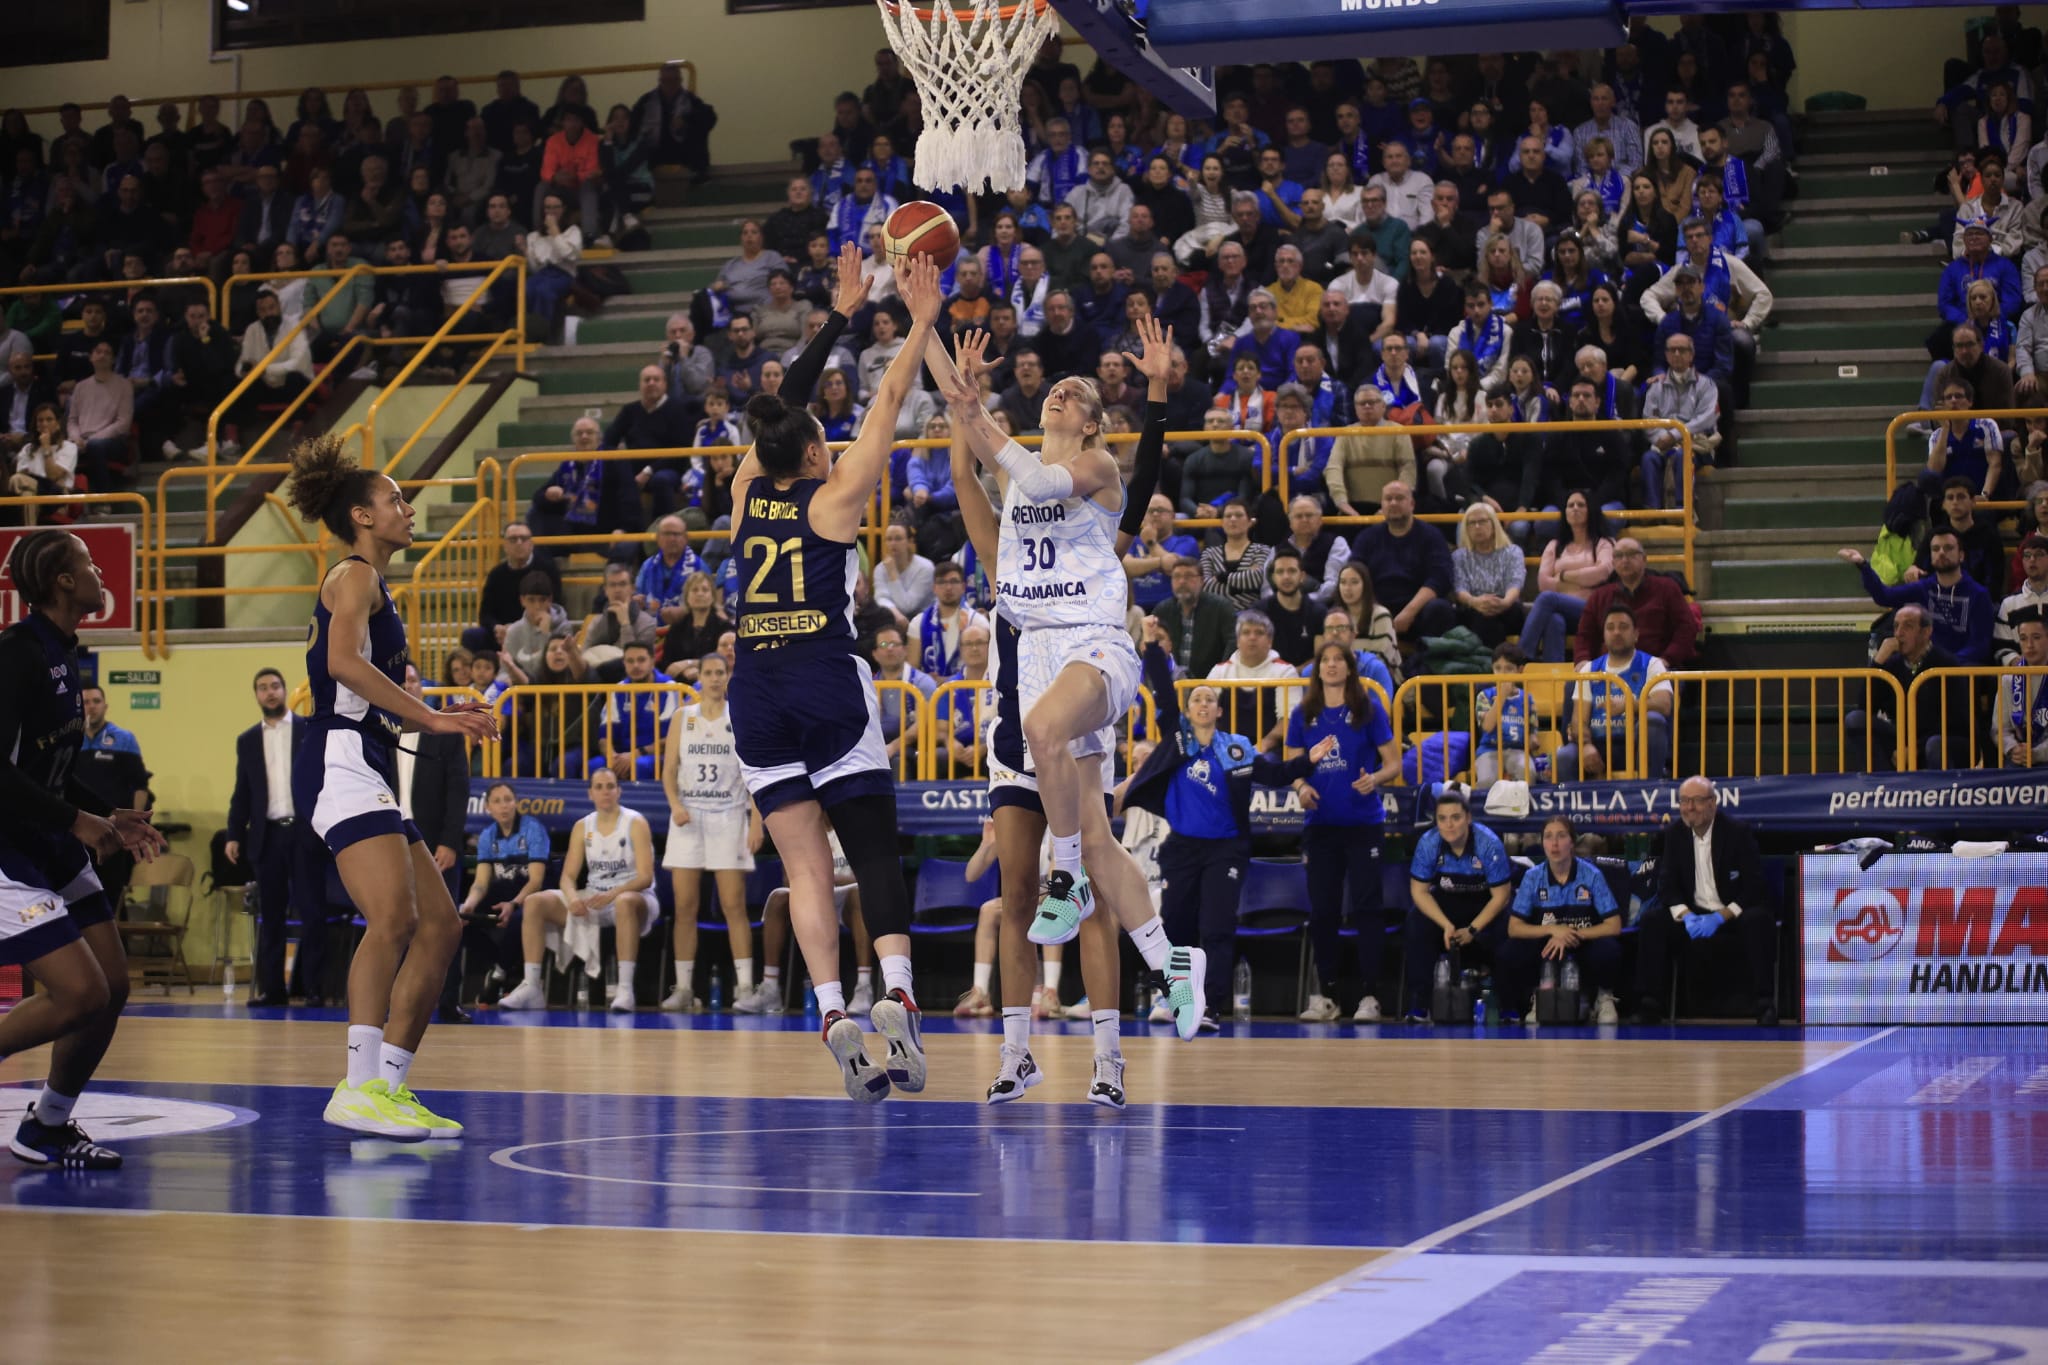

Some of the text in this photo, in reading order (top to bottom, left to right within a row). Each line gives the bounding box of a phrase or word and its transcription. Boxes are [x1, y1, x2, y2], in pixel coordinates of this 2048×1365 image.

[1023, 537, 1056, 571] 30
[743, 536, 806, 603] 21
[996, 581, 1087, 600] SALAMANCA
[127, 671, 157, 683] SALIDA
[688, 743, 731, 755] AVENIDA
[697, 764, 718, 782] 33
[1641, 789, 1659, 811] Y
